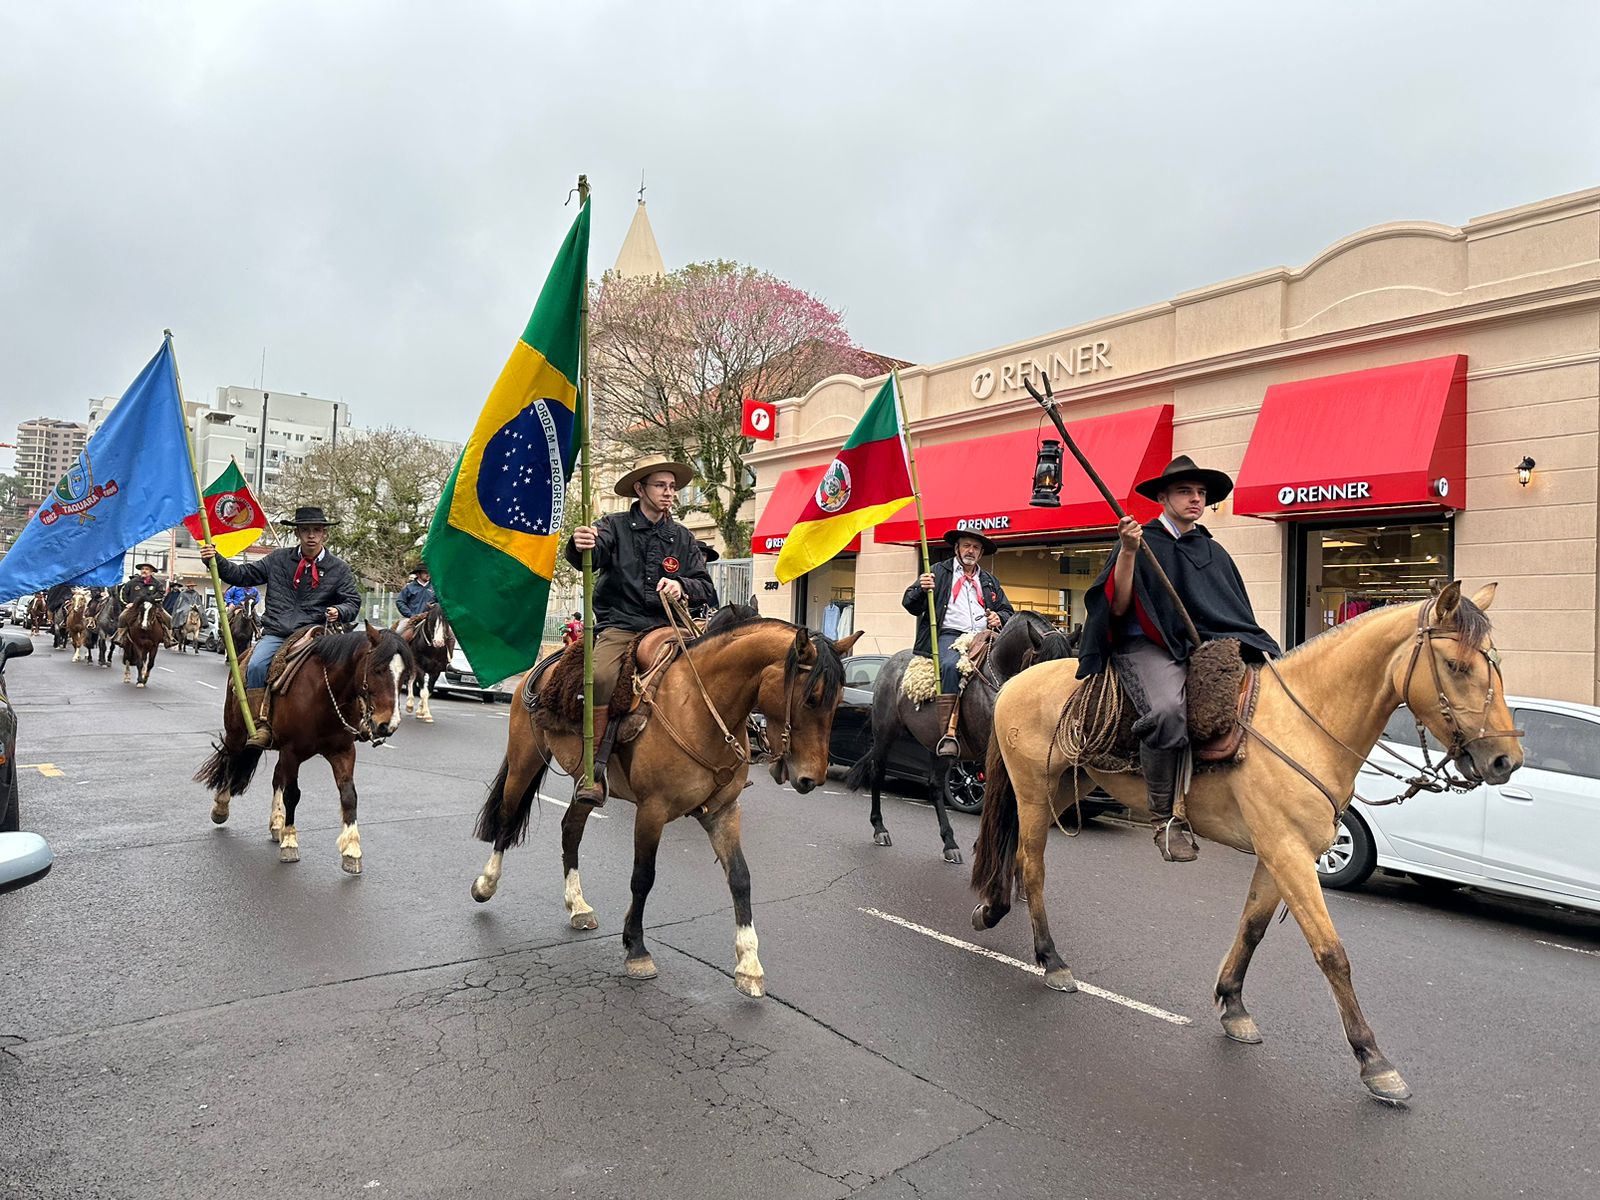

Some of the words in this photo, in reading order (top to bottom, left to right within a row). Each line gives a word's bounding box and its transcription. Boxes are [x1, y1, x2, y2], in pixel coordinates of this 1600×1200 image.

[1000, 340, 1113, 393] RENNER
[537, 402, 556, 443] ORDEM
[550, 458, 563, 529] PROGRESSO
[1297, 481, 1370, 503] RENNER
[62, 494, 99, 513] TAQUARA
[968, 516, 1009, 530] RENNER
[773, 537, 785, 548] REN
